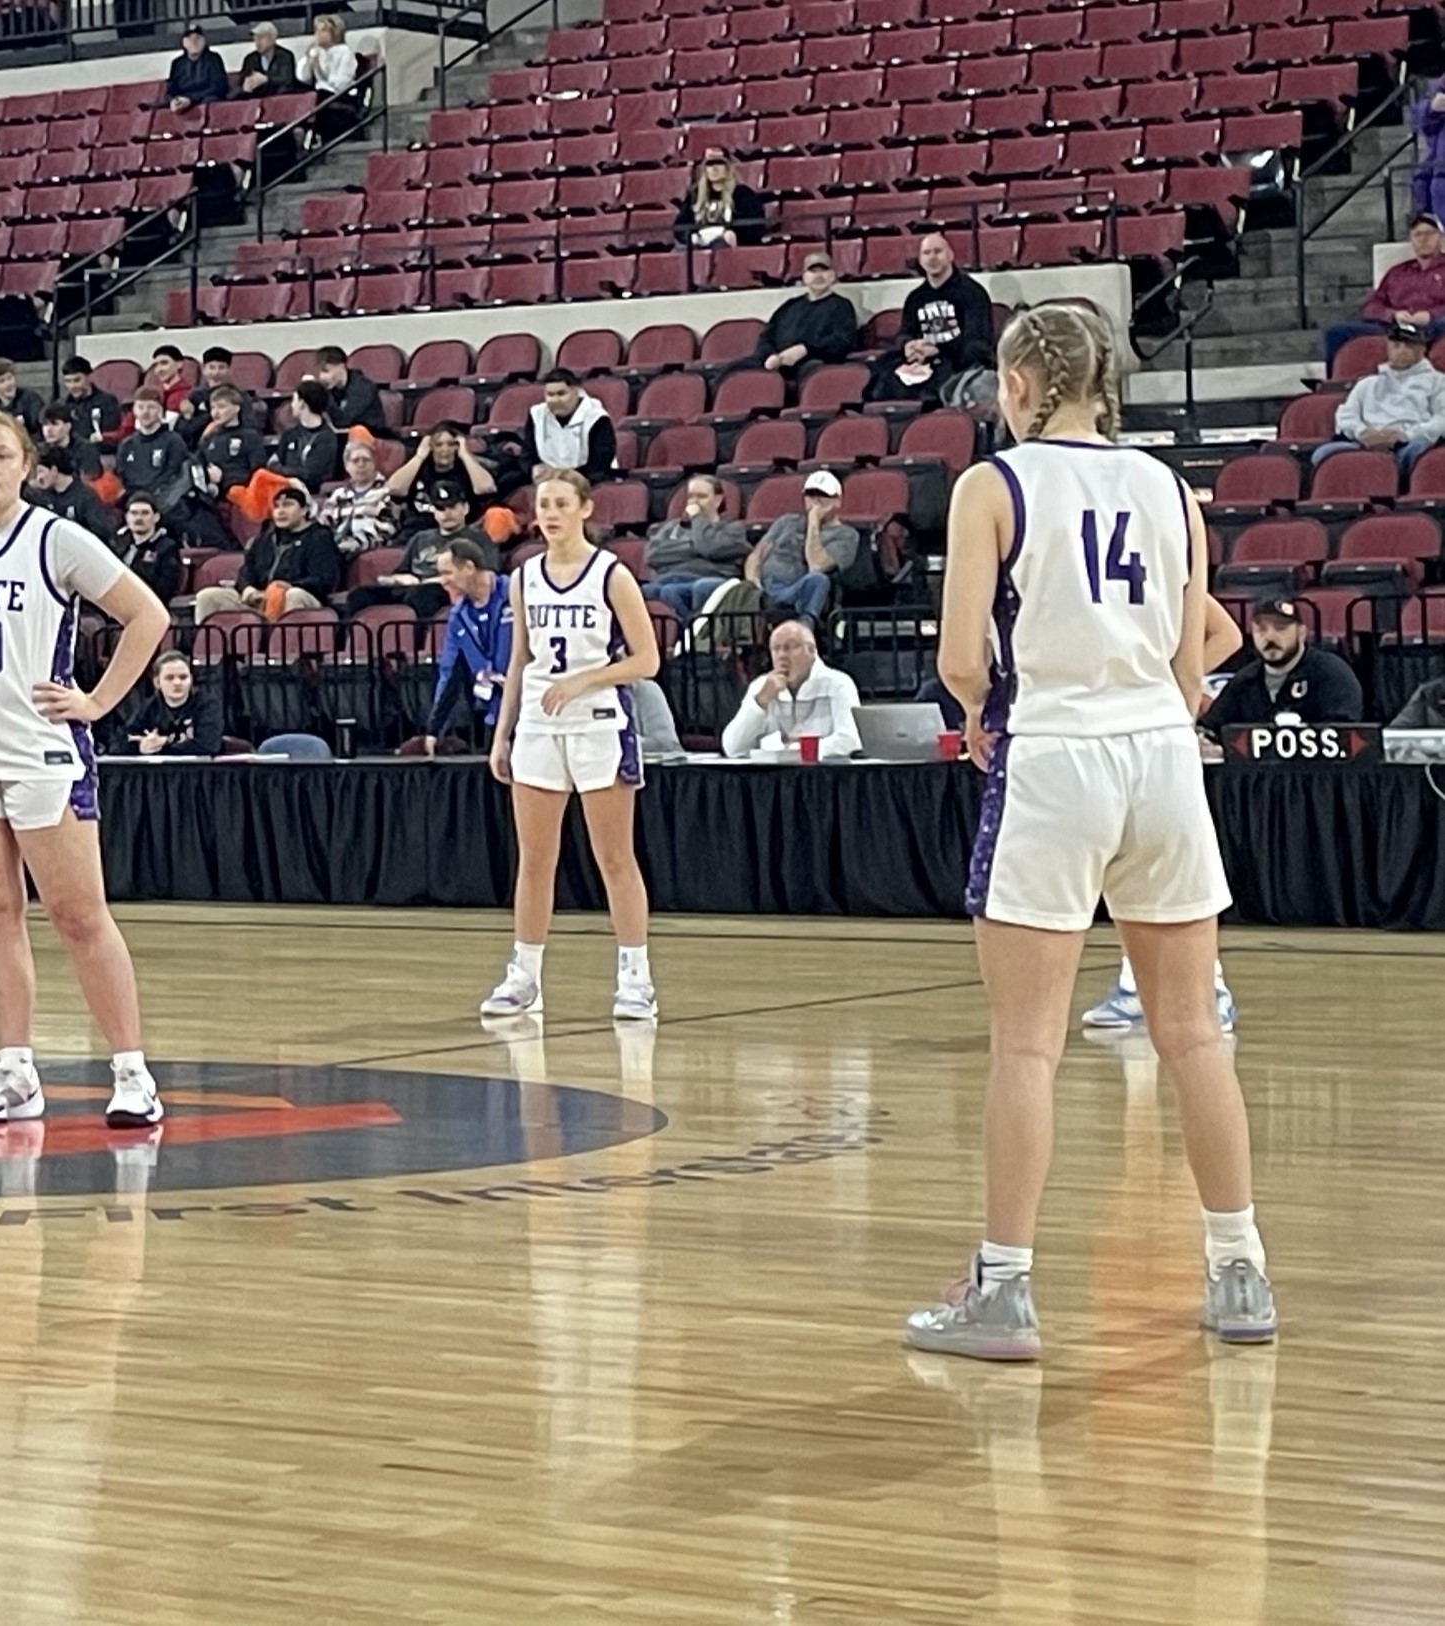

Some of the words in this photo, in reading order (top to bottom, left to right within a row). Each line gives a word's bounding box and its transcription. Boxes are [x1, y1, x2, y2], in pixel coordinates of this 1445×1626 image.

[1081, 509, 1147, 605] 14
[550, 636, 567, 674] 3
[1251, 728, 1347, 759] POSS.
